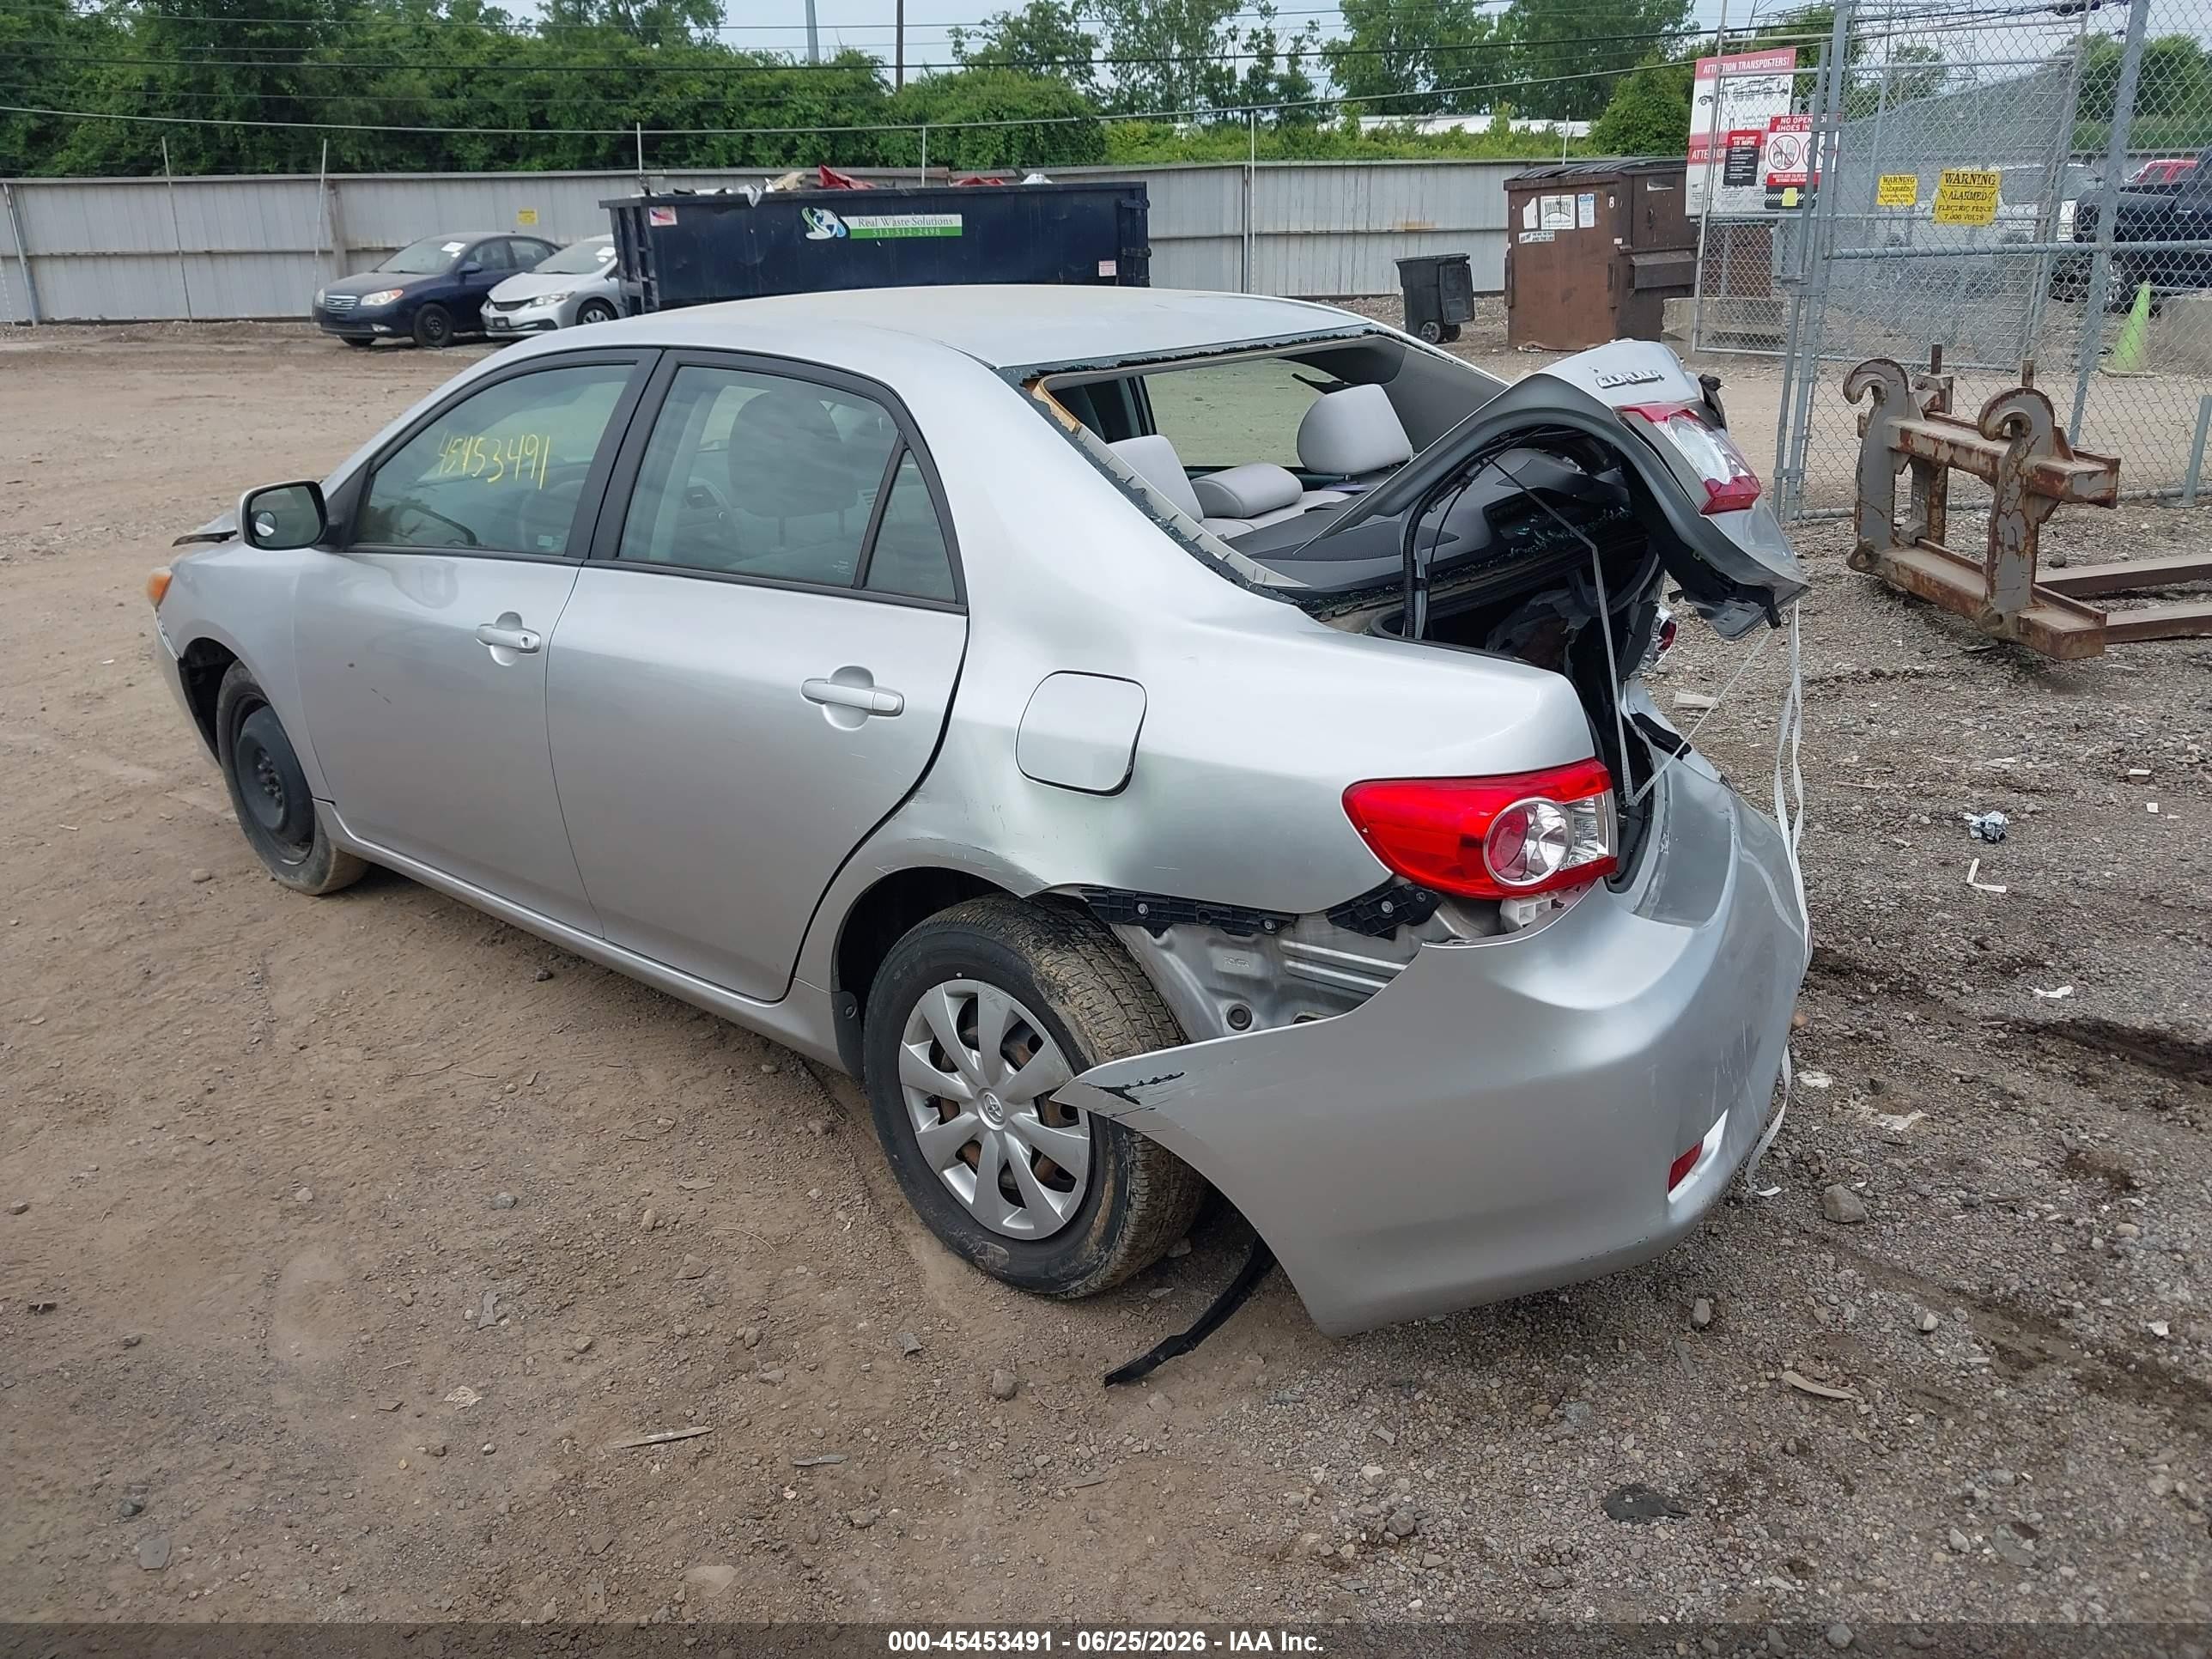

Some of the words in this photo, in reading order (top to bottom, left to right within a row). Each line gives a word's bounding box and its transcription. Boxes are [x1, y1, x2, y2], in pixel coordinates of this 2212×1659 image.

[1703, 61, 1737, 75] ATTTION
[1738, 57, 1790, 70] TRANSPORTERS!
[1691, 146, 1727, 161] ATTETION
[1944, 173, 1996, 185] WARNING
[1608, 196, 1614, 208] 8
[1948, 191, 1988, 201] ALARMED
[858, 217, 878, 228] Real
[879, 217, 910, 228] Waste
[911, 216, 954, 227] Solutions
